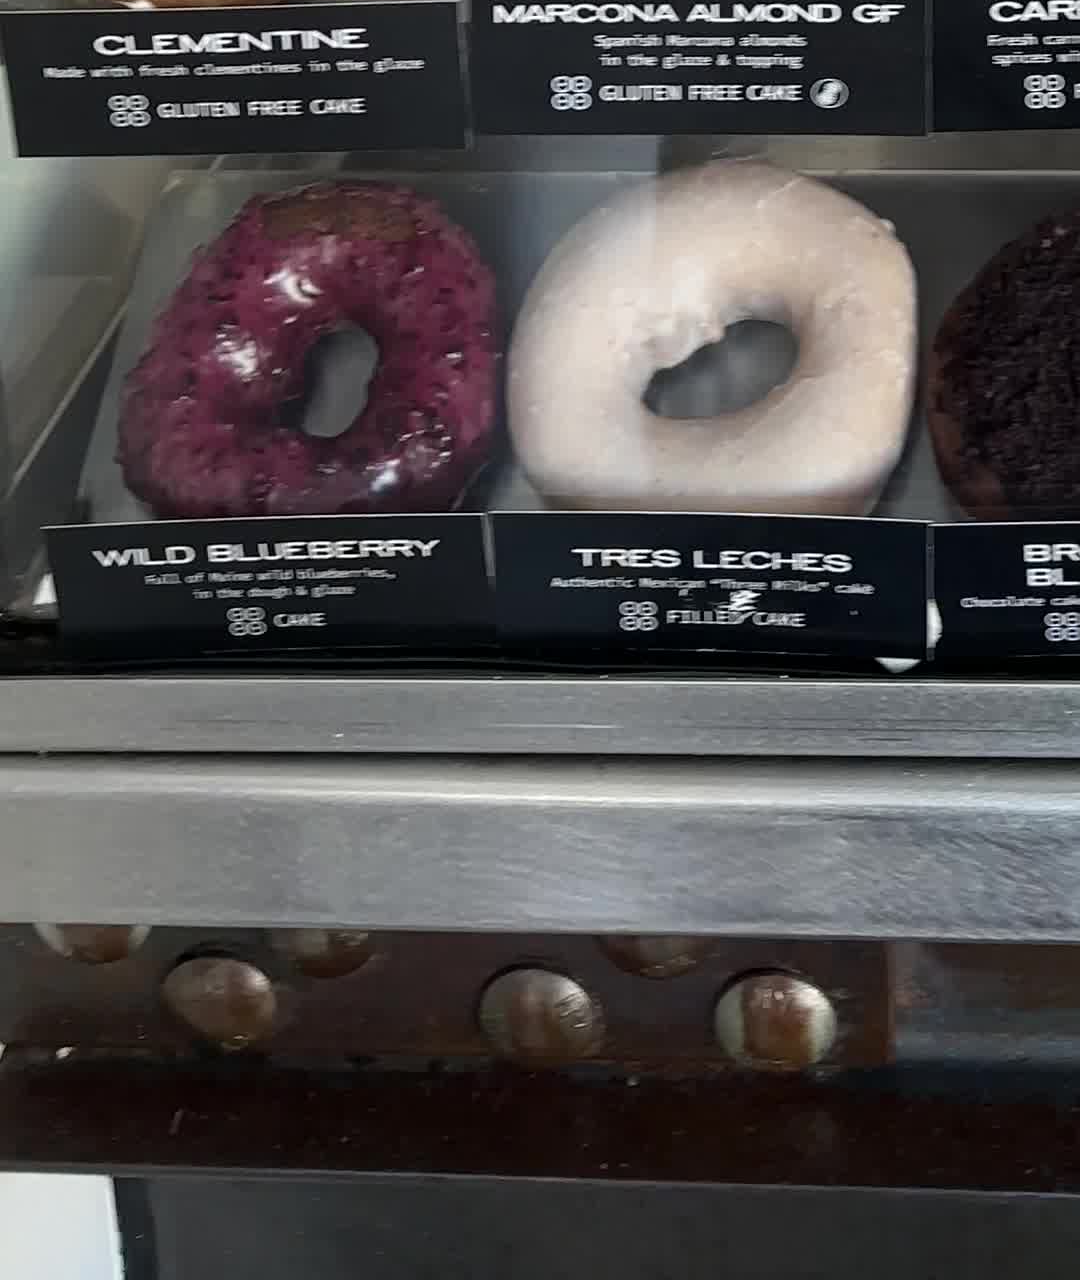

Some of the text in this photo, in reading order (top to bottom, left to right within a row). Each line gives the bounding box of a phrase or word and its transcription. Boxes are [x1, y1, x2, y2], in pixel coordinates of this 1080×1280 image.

[492, 3, 906, 24] MARCONA ALMOND GF
[93, 28, 369, 56] CLEMENTINE
[599, 84, 803, 101] GLUTEN FREE CAKE
[156, 98, 368, 119] GLUTEN FREE CAKE
[91, 539, 441, 567] WILD BLUEBERRY
[571, 548, 853, 573] TRES LECHES
[273, 613, 328, 628] CAKE
[752, 611, 808, 628] CAKE
